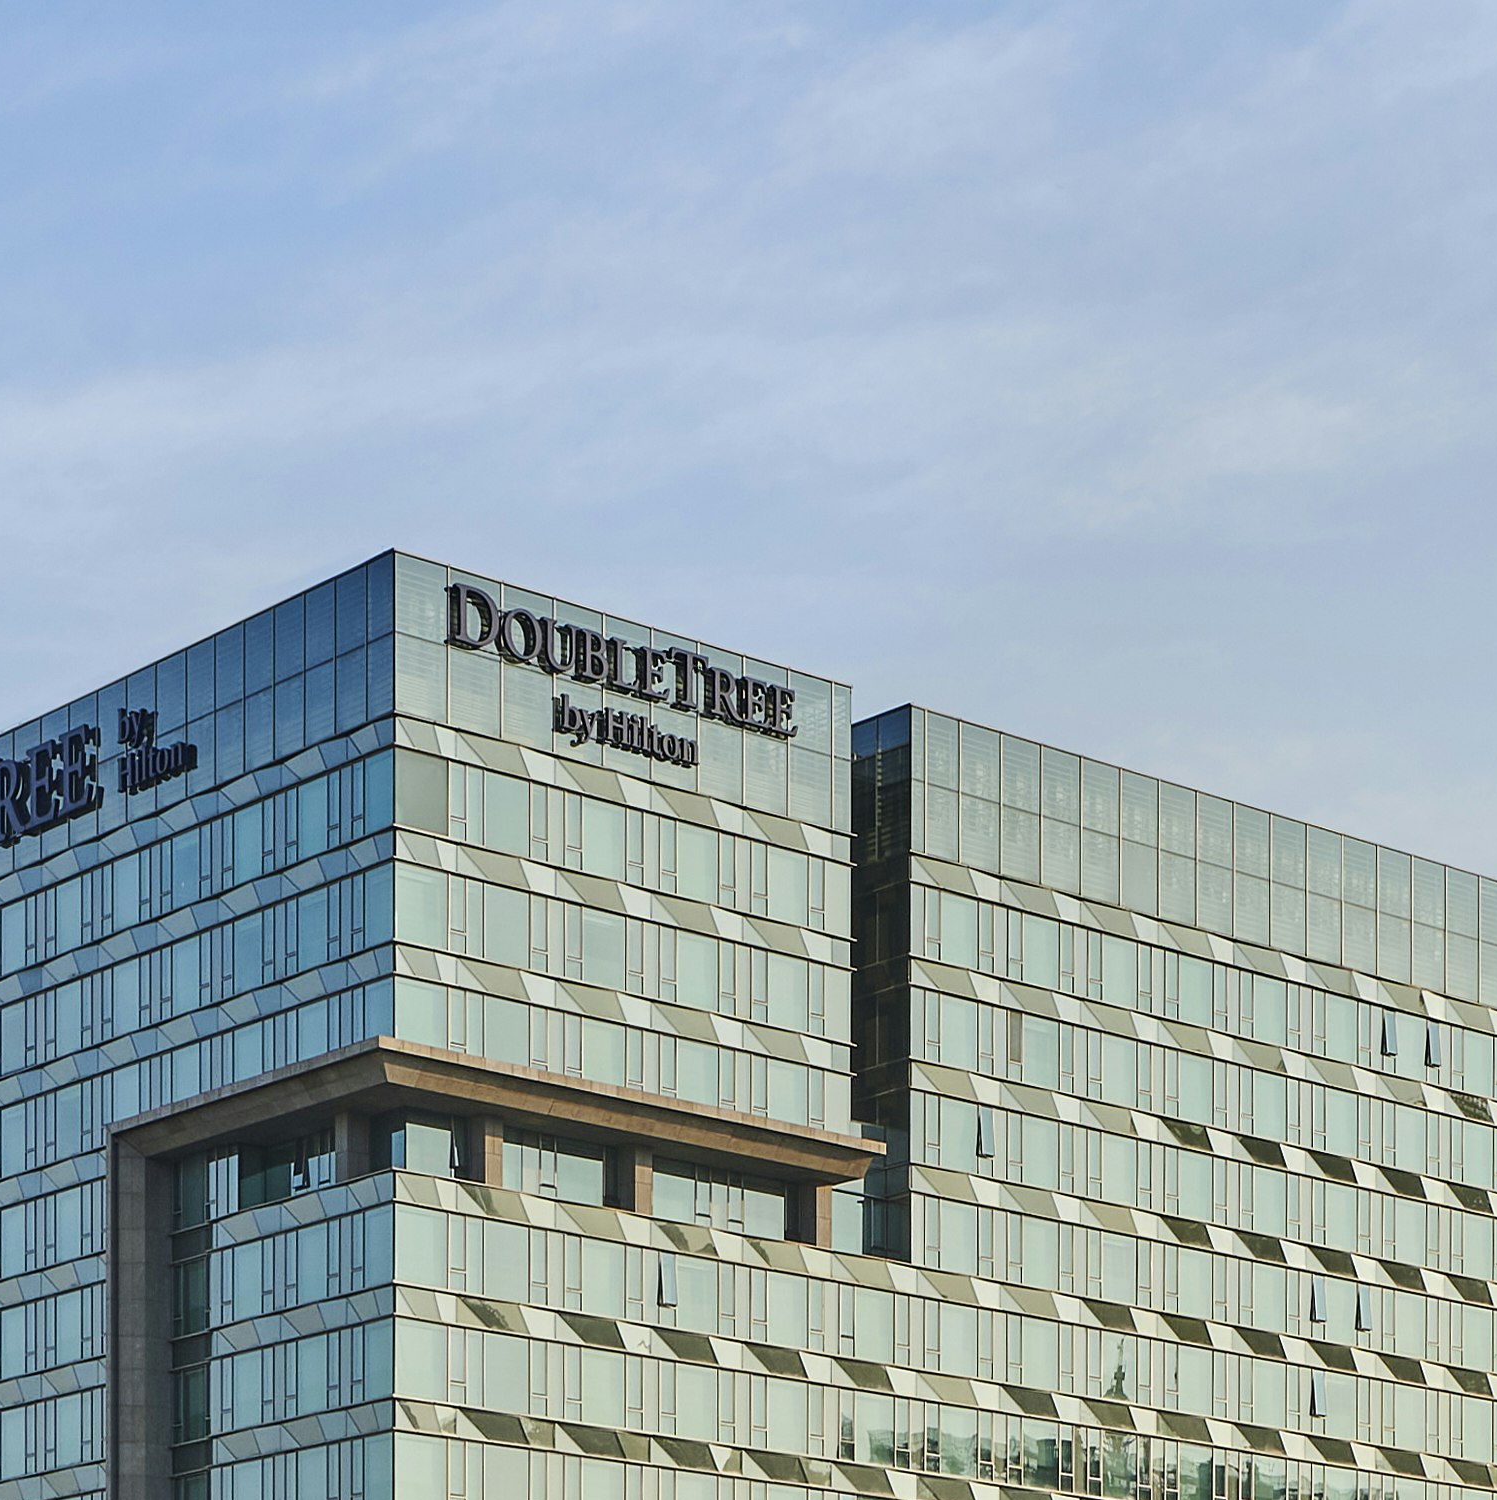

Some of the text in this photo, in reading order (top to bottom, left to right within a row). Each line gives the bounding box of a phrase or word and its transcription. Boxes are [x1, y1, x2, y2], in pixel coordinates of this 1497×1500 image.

[117, 708, 158, 747] by
[552, 694, 699, 768] by Hilton
[117, 741, 198, 795] Hilton
